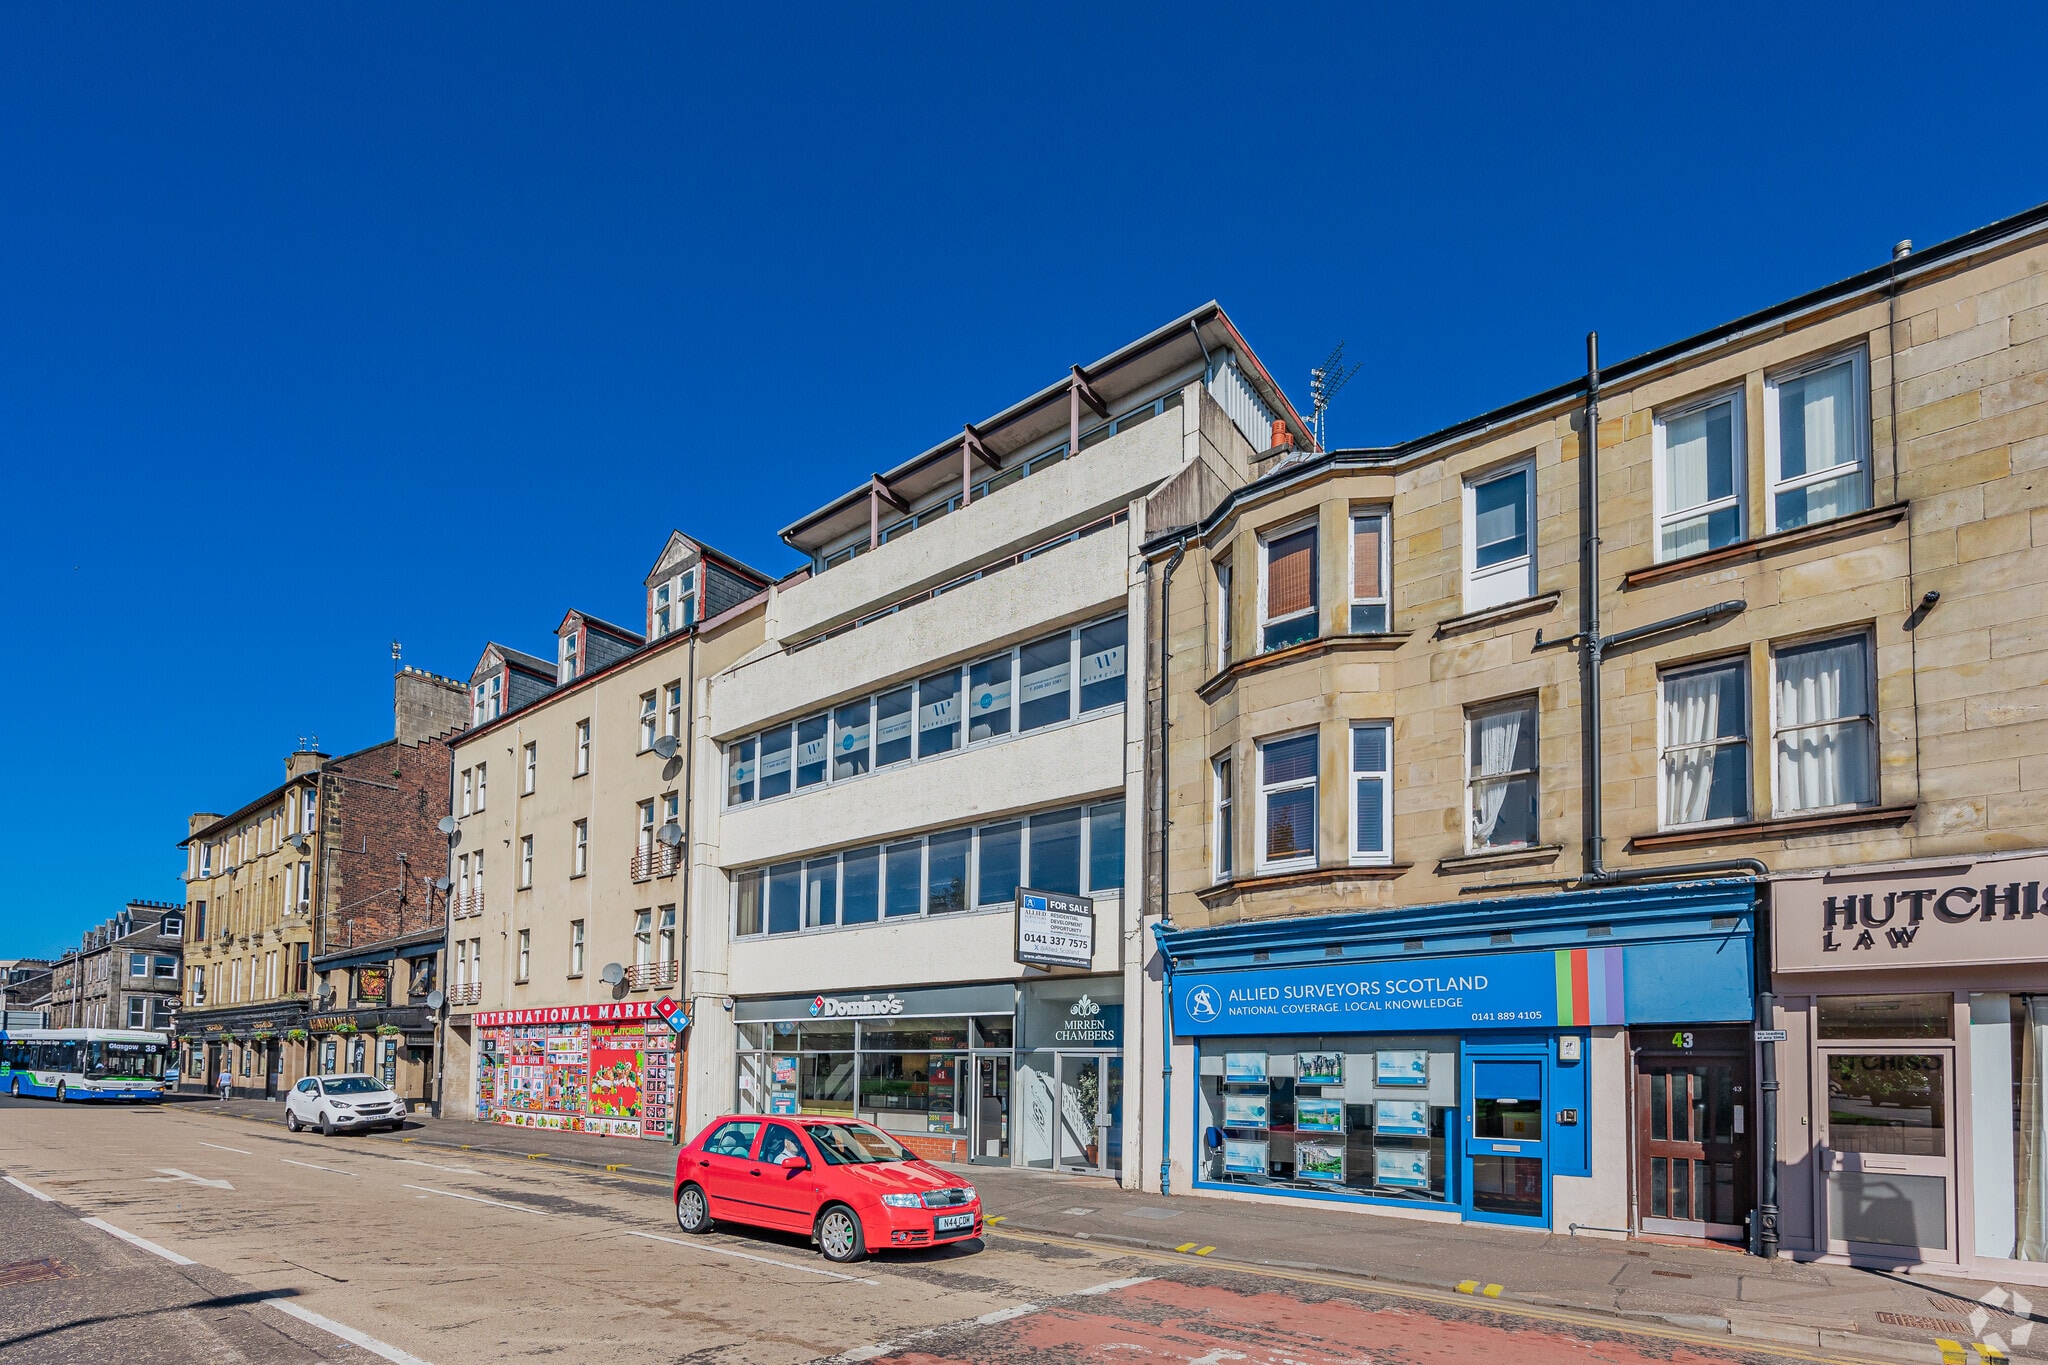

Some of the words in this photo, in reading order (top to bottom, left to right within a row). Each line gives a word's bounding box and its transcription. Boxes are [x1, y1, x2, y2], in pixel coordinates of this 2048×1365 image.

[1050, 900, 1067, 911] FOR
[1068, 903, 1089, 914] SALE
[1050, 912, 1079, 921] RESIDENTIAL
[1050, 918, 1083, 927] DEVELOPMENT
[1050, 924, 1082, 933] OPPORTUNITY
[1024, 933, 1047, 944] 0141
[1050, 936, 1066, 946] 337
[1068, 938, 1088, 949] 7575
[1824, 926, 1920, 951] LAW
[1228, 986, 1280, 1002] ALLIED
[1283, 980, 1381, 999] SURVEYORS
[1385, 975, 1488, 995] SCOTLAND
[824, 993, 904, 1017] Domino's
[1228, 1005, 1279, 1016] NATIONAL
[1281, 1002, 1342, 1014] COVERAGE.
[1345, 999, 1382, 1012] LOCAL
[1385, 997, 1464, 1010] KNOWLEDGE
[475, 1006, 591, 1025] INTERNATIONAL
[598, 1002, 661, 1019] MARKE
[1471, 1011, 1495, 1021] 0141
[1497, 1011, 1515, 1021] 889
[1517, 1010, 1542, 1020] 4105
[1064, 1019, 1105, 1030] MIRREN
[591, 1027, 611, 1036] HALAL
[613, 1026, 645, 1036] UTCHERS
[1055, 1030, 1115, 1041] CHAMBERS
[1671, 1032, 1694, 1048] 43
[108, 1042, 139, 1051] Glasgow
[144, 1044, 157, 1053] 38
[944, 1217, 957, 1228] N44
